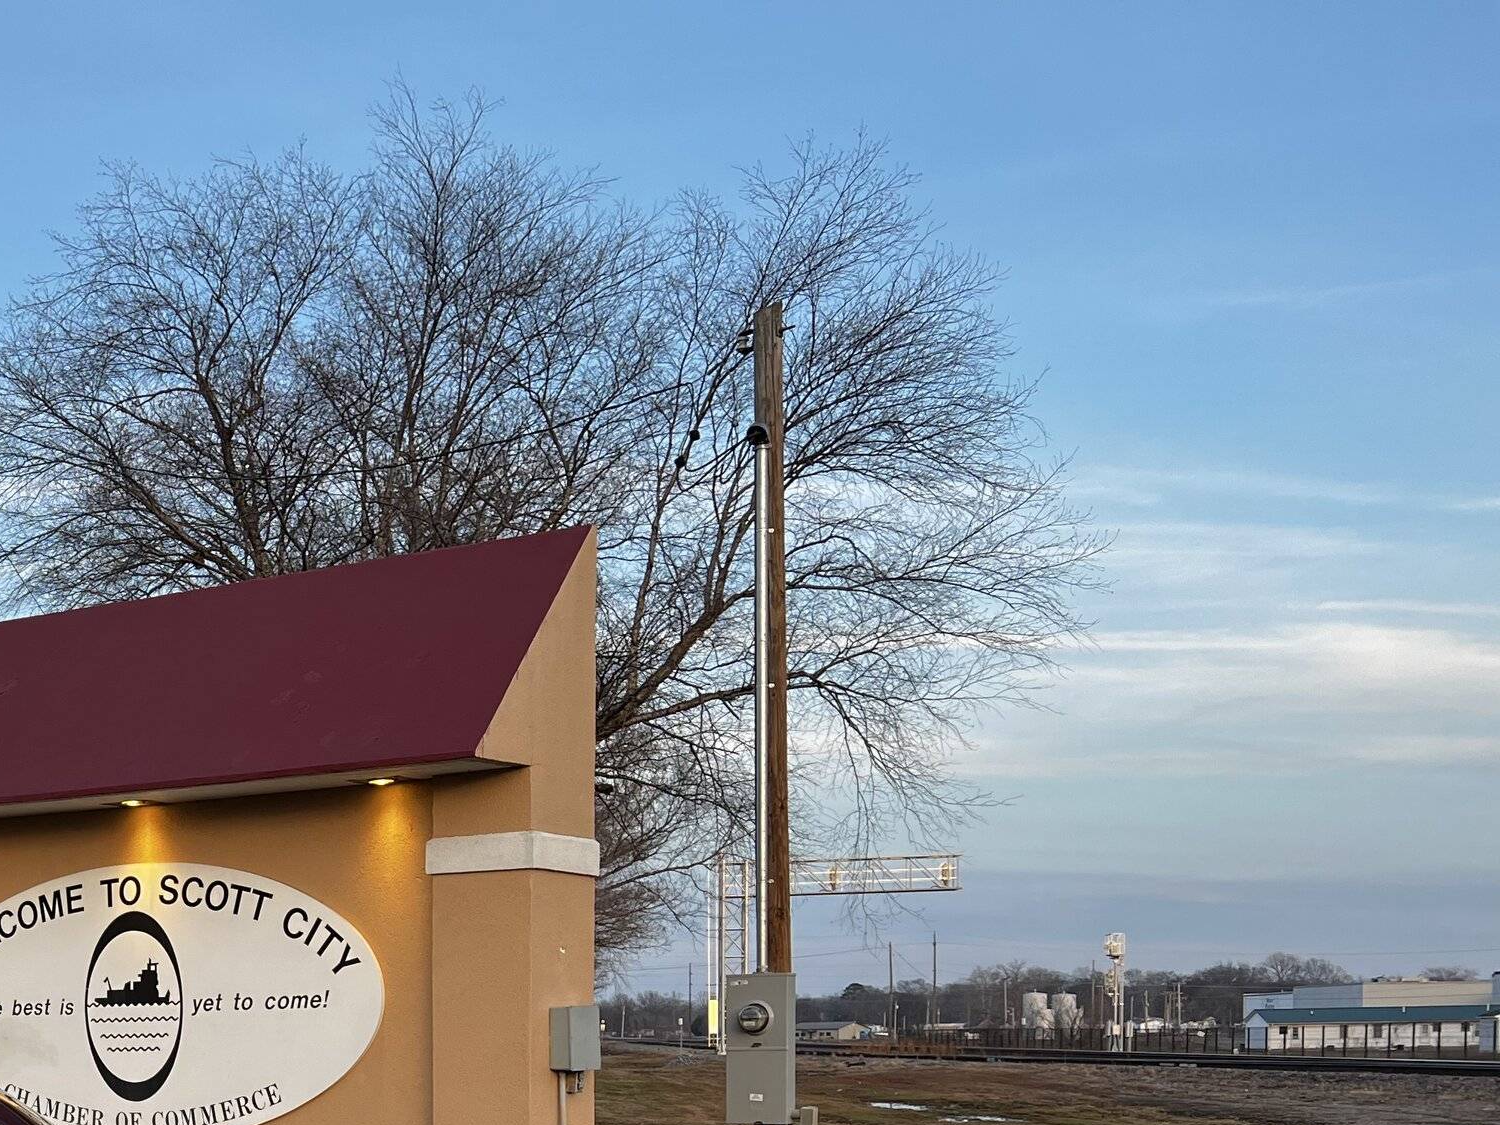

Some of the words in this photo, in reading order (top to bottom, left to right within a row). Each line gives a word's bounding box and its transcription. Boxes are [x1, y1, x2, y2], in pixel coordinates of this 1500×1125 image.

[99, 875, 141, 908] TO
[158, 874, 274, 922] SCOTT
[282, 907, 362, 976] CITY
[11, 998, 51, 1016] best
[59, 998, 74, 1016] is
[191, 993, 223, 1017] yet
[234, 992, 253, 1011] to
[264, 989, 330, 1010] come!
